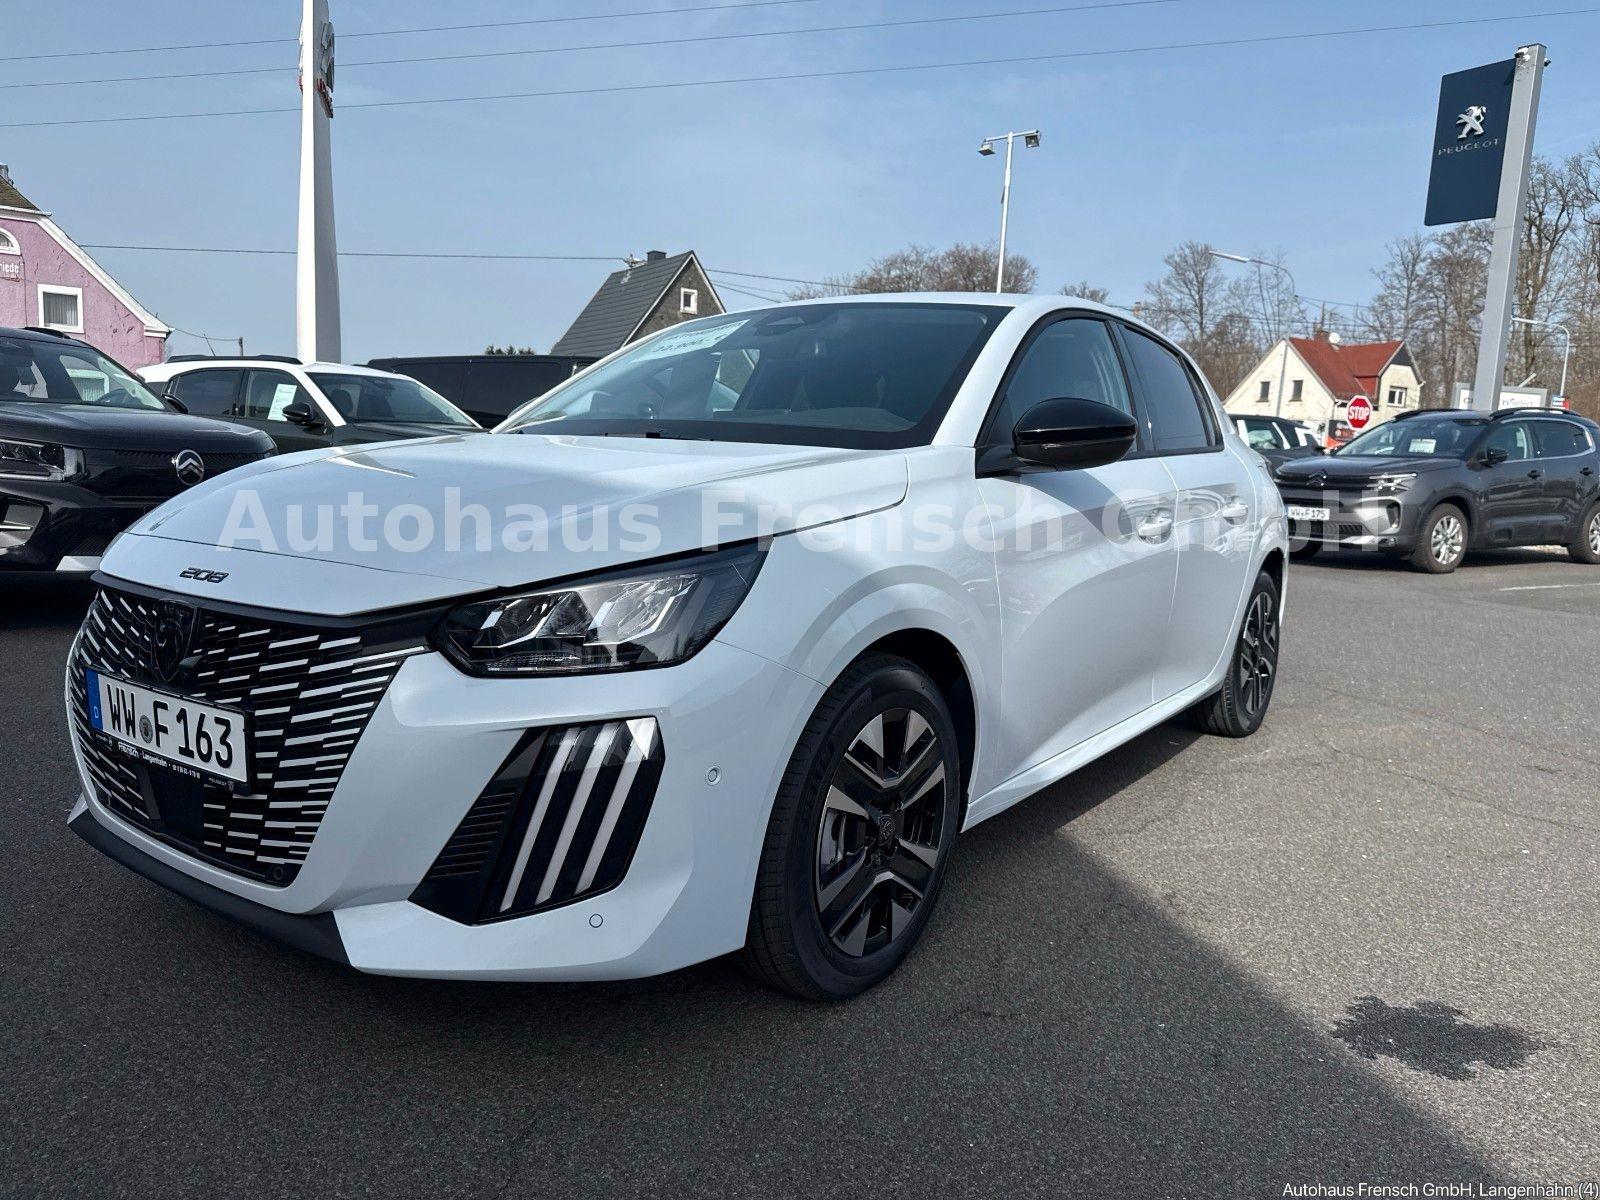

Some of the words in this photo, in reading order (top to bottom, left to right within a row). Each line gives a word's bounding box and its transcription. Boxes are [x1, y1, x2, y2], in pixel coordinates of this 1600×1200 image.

[1438, 139, 1499, 155] PEUGEOT
[1349, 406, 1369, 420] STOP
[179, 567, 229, 583] 208
[107, 684, 136, 738] WW
[153, 700, 169, 747] F
[176, 707, 233, 769] 163
